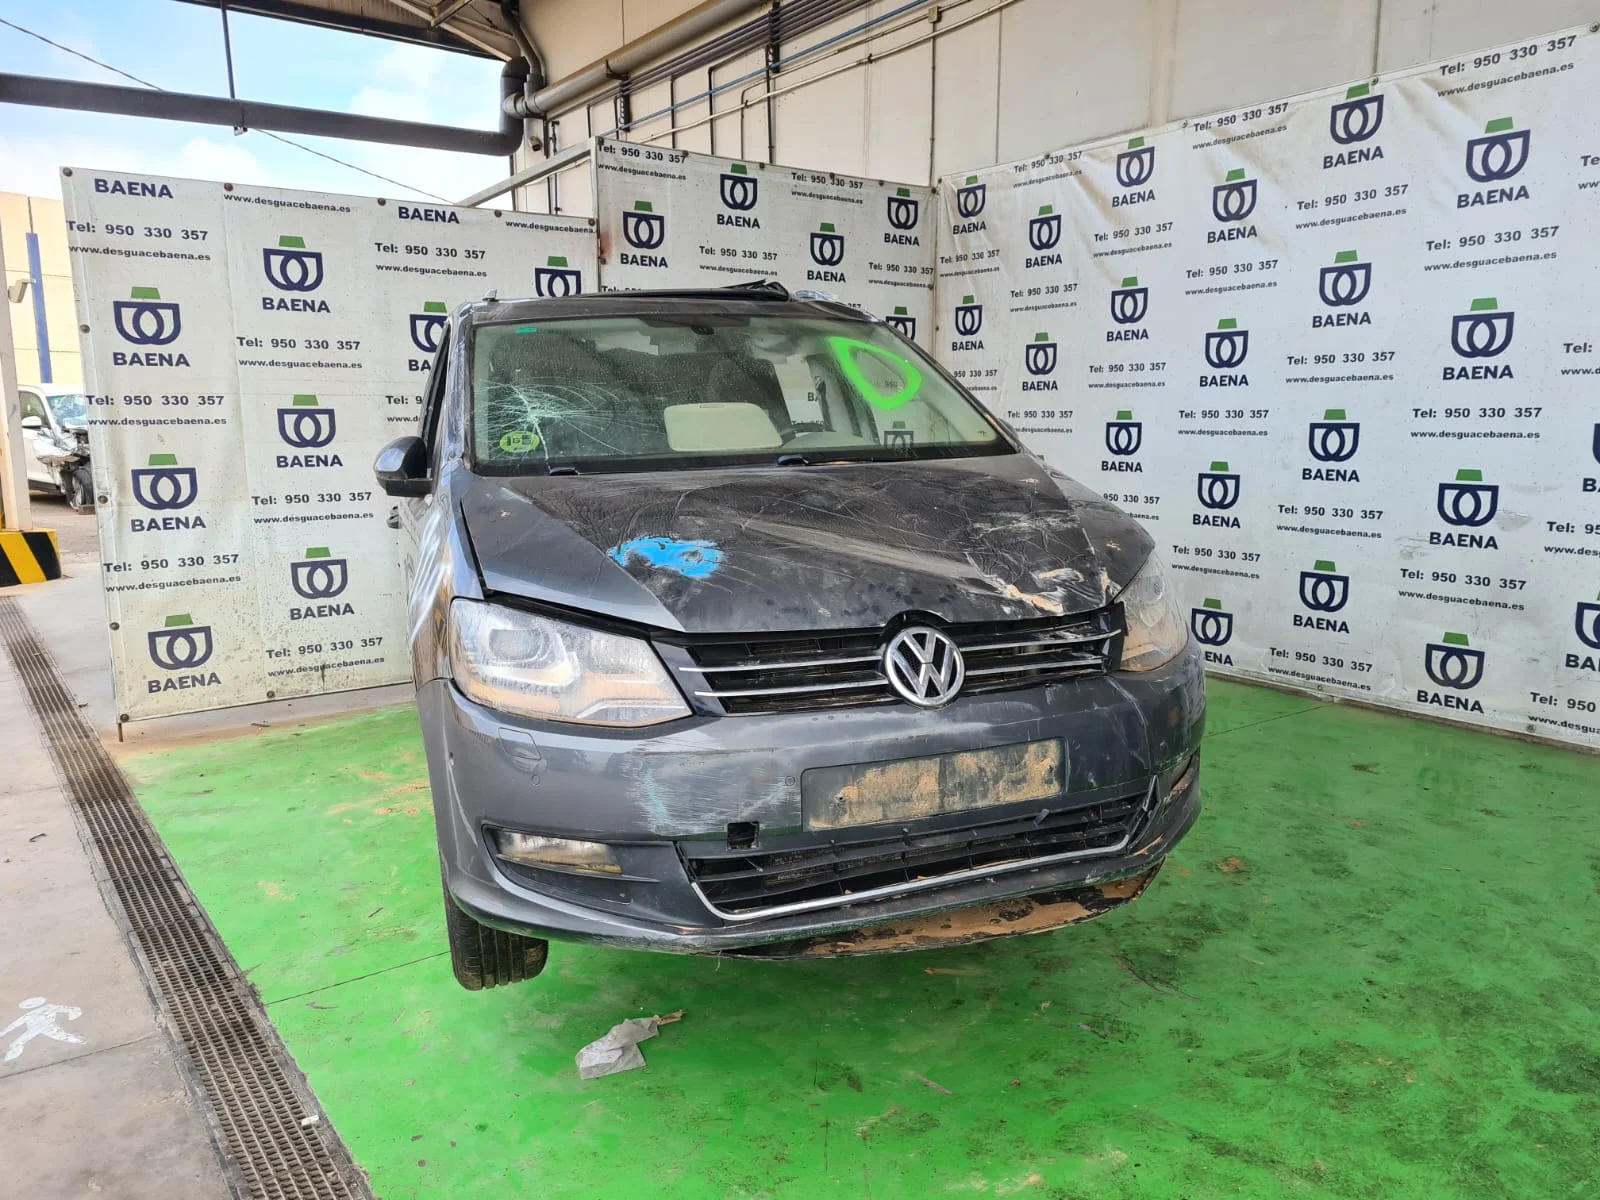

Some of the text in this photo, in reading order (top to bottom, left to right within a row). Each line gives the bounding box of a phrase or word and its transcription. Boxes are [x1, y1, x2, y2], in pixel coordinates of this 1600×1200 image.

[1438, 34, 1577, 76] Tel: 950 330 357
[1437, 63, 1574, 97] www.desguacebaena.es
[1193, 102, 1289, 132] Tel: 950 330 357
[1193, 125, 1287, 150] www.desguacebaena.es
[1323, 146, 1384, 170] BAENA
[94, 178, 174, 199] BAENA
[223, 194, 351, 213] www.desguacebaena.es
[1112, 189, 1156, 208] BAENA
[1297, 184, 1408, 211] Tel: 950 330 357
[1457, 185, 1530, 209] BAENA
[398, 206, 460, 224] BAENA
[716, 213, 760, 229] BAENA
[1296, 209, 1407, 229] www.desguacebaena.es
[66, 220, 208, 241] Tel: 950 330 357
[952, 220, 987, 235] BAENA
[1094, 221, 1173, 242] Tel: 950 330 357
[1207, 225, 1258, 244] BAENA
[884, 232, 920, 247] BAENA
[1426, 225, 1560, 251] Tel: 950 330 357
[68, 246, 211, 261] www.desguacebaena.es
[374, 242, 486, 260] Tel: 950 330 357
[699, 245, 778, 261] Tel: 950 330 357
[620, 252, 668, 268] BAENA
[1025, 253, 1063, 269] BAENA
[1424, 252, 1557, 271] www.desguacebaena.es
[376, 265, 487, 277] www.desguacebaena.es
[807, 270, 846, 283] BAENA
[1186, 259, 1278, 279] Tel: 950 330 357
[1010, 283, 1078, 298] Tel: 950 330 357
[1185, 281, 1277, 295] www.desguacebaena.es
[262, 297, 331, 313] BAENA
[1312, 312, 1372, 328] BAENA
[236, 336, 360, 350] Tel: 950 330 357
[1106, 328, 1149, 342] BAENA
[952, 340, 984, 351] BAENA
[1563, 342, 1592, 354] Tel:
[112, 352, 190, 367] BAENA
[238, 359, 362, 368] www.desguacebaena.es
[1287, 351, 1395, 365] Tel: 950 330 357
[1089, 362, 1166, 373] Tel: 950 330 357
[1442, 364, 1514, 381] BAENA
[1022, 380, 1058, 391] BAENA
[1199, 374, 1249, 387] BAENA
[1285, 374, 1394, 384] www.desguacebaena.es
[85, 395, 224, 406] Tel: 950 330 357
[1178, 409, 1269, 419] Tel: 950 330 357
[1412, 407, 1542, 418] Tel: 950 330 357
[88, 417, 227, 427] www.desguacebaena.es
[1410, 430, 1540, 440] www.desguacebaena.es
[276, 454, 344, 468] BAENA
[1101, 460, 1143, 473] BAENA
[1302, 468, 1360, 483] BAENA
[251, 492, 372, 505] Tel: 950 330 357
[253, 513, 374, 524] www.desguacebaena.es
[1277, 504, 1384, 520] Tel: 950 330 357
[131, 516, 206, 532] BAENA
[1192, 513, 1241, 529] BAENA
[1546, 521, 1575, 533] Tel:
[1276, 525, 1382, 538] www.desguacebaena.es
[1429, 531, 1499, 550] BAENA
[1172, 545, 1261, 562] Tel: 950 330 357
[103, 554, 239, 573] Tel: 950 330 357
[1172, 564, 1260, 579] www.desguacebaena.es
[105, 576, 241, 592] www.desguacebaena.es
[1400, 568, 1527, 590] Tel: 950 330 357
[1398, 590, 1525, 611] www.desguacebaena.es
[290, 603, 355, 620] BAENA
[1293, 614, 1350, 634] BAENA
[265, 637, 383, 659] Tel: 950 330 357
[1269, 647, 1373, 672] Tel: 950 330 357
[148, 672, 222, 694] BAENA
[1268, 667, 1371, 691] www.desguacebaena.es
[1416, 689, 1484, 714] BAENA
[1530, 692, 1596, 712] Tel: 950
